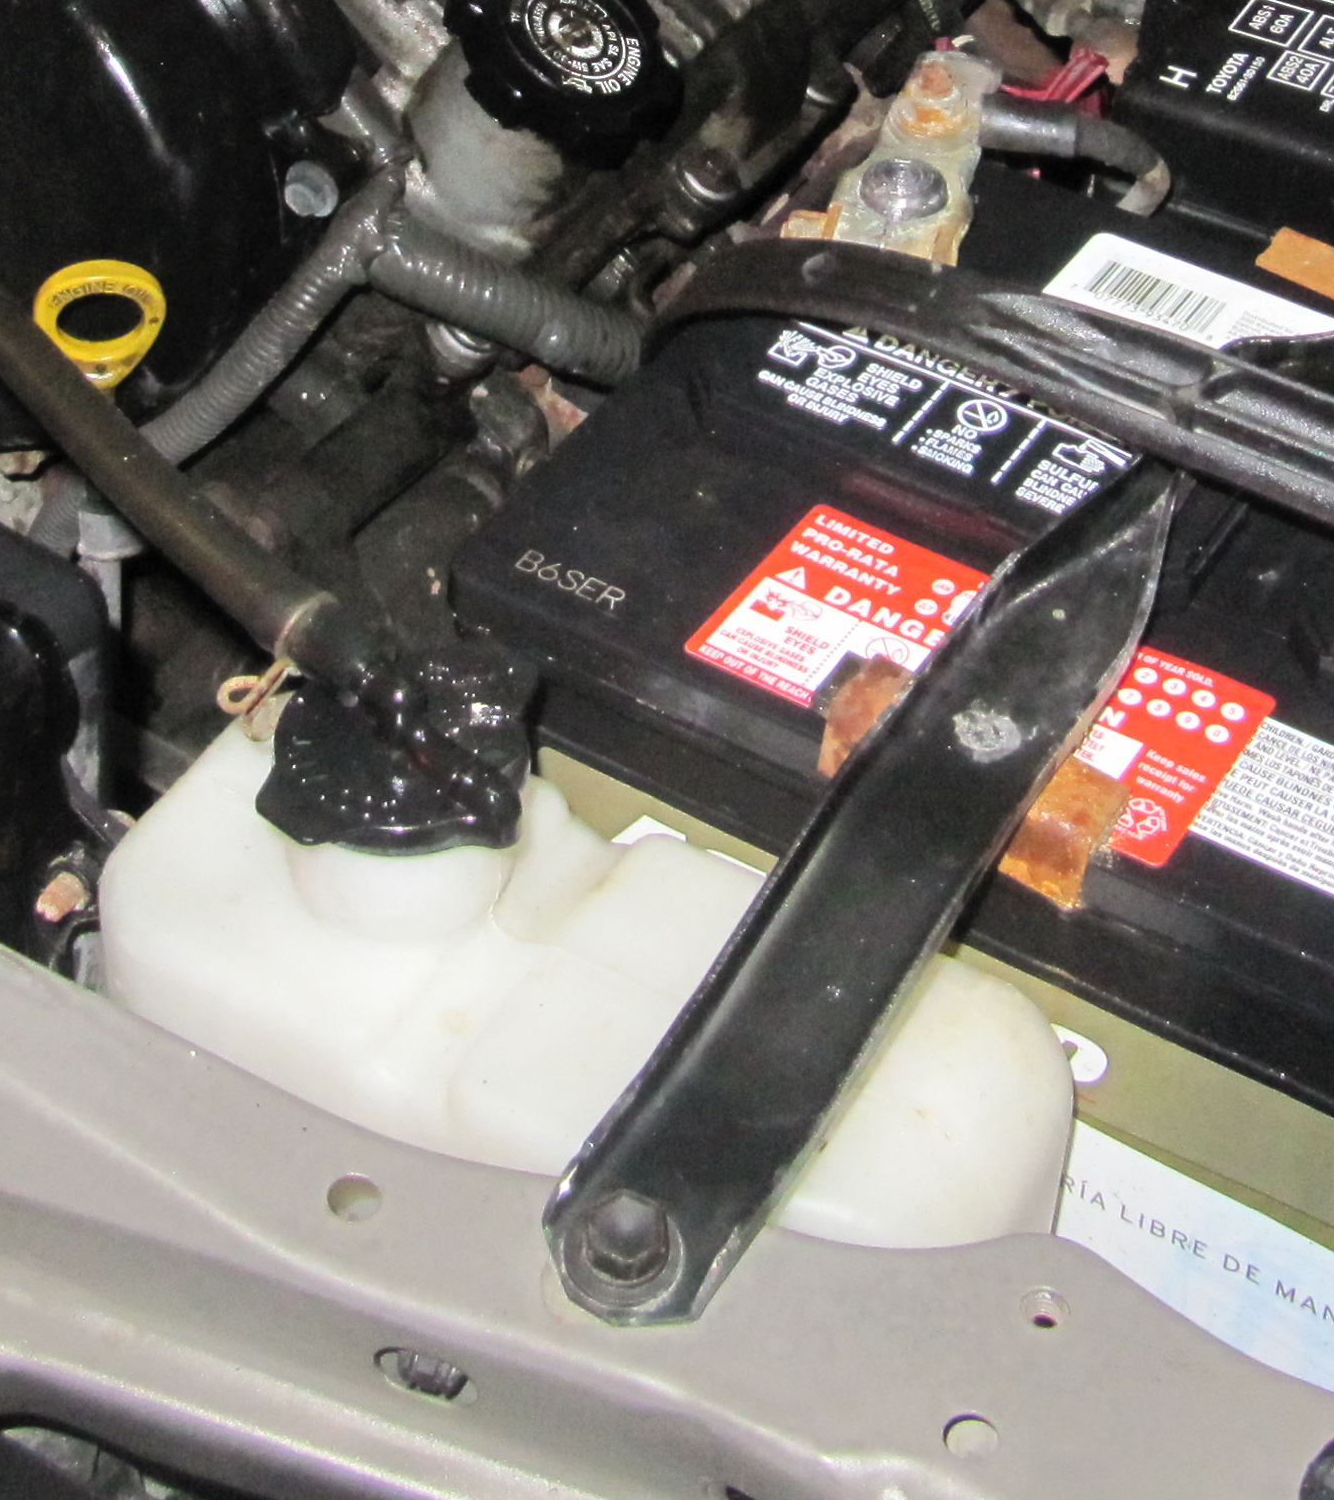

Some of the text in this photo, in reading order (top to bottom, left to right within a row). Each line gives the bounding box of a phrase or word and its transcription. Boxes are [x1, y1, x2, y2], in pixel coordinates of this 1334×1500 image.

[1247, 3, 1276, 30] ABS1
[1268, 13, 1295, 34] 60A
[595, 36, 642, 95] ENGINE OIL
[1158, 64, 1198, 89] H
[1204, 52, 1249, 94] TOYOTA
[1276, 54, 1304, 81] ABS2
[1295, 62, 1320, 84] 40A
[804, 375, 859, 403] GASES
[812, 366, 900, 407] EXPLOSIVE
[855, 371, 900, 394] EYES
[864, 362, 923, 390] SHIELD
[757, 369, 887, 428] CAN CAUSE BLINDNESS
[786, 391, 850, 423] OR INJURY
[931, 428, 982, 454] SPARKS
[950, 423, 978, 440] NO
[916, 444, 974, 475] SMOKING
[923, 436, 974, 462] FLAMES
[1021, 476, 1077, 507] BLINDNE
[1029, 468, 1059, 487] CAN
[813, 513, 894, 555] LIMITED
[789, 539, 901, 596] WARRANTY
[800, 526, 898, 578] PRO-RATA
[825, 586, 948, 647] DANGE
[782, 635, 816, 655] EYES
[784, 625, 830, 650] SHIELD
[697, 643, 810, 700] KEEP OUT OF THE REACH
[1143, 654, 1213, 688] OF YEAR SOLD.
[1136, 761, 1195, 792] receipt for
[1144, 748, 1207, 783] Keep sales
[1134, 774, 1185, 804] warranty
[1237, 760, 1276, 782] CAUSE
[1275, 776, 1332, 806] BLINDNES
[1238, 772, 1270, 790] PEUT
[1268, 786, 1314, 812] CAUSER
[1312, 805, 1329, 819] LA
[1120, 1204, 1208, 1258] LIBRE
[1221, 1254, 1261, 1287] DE
